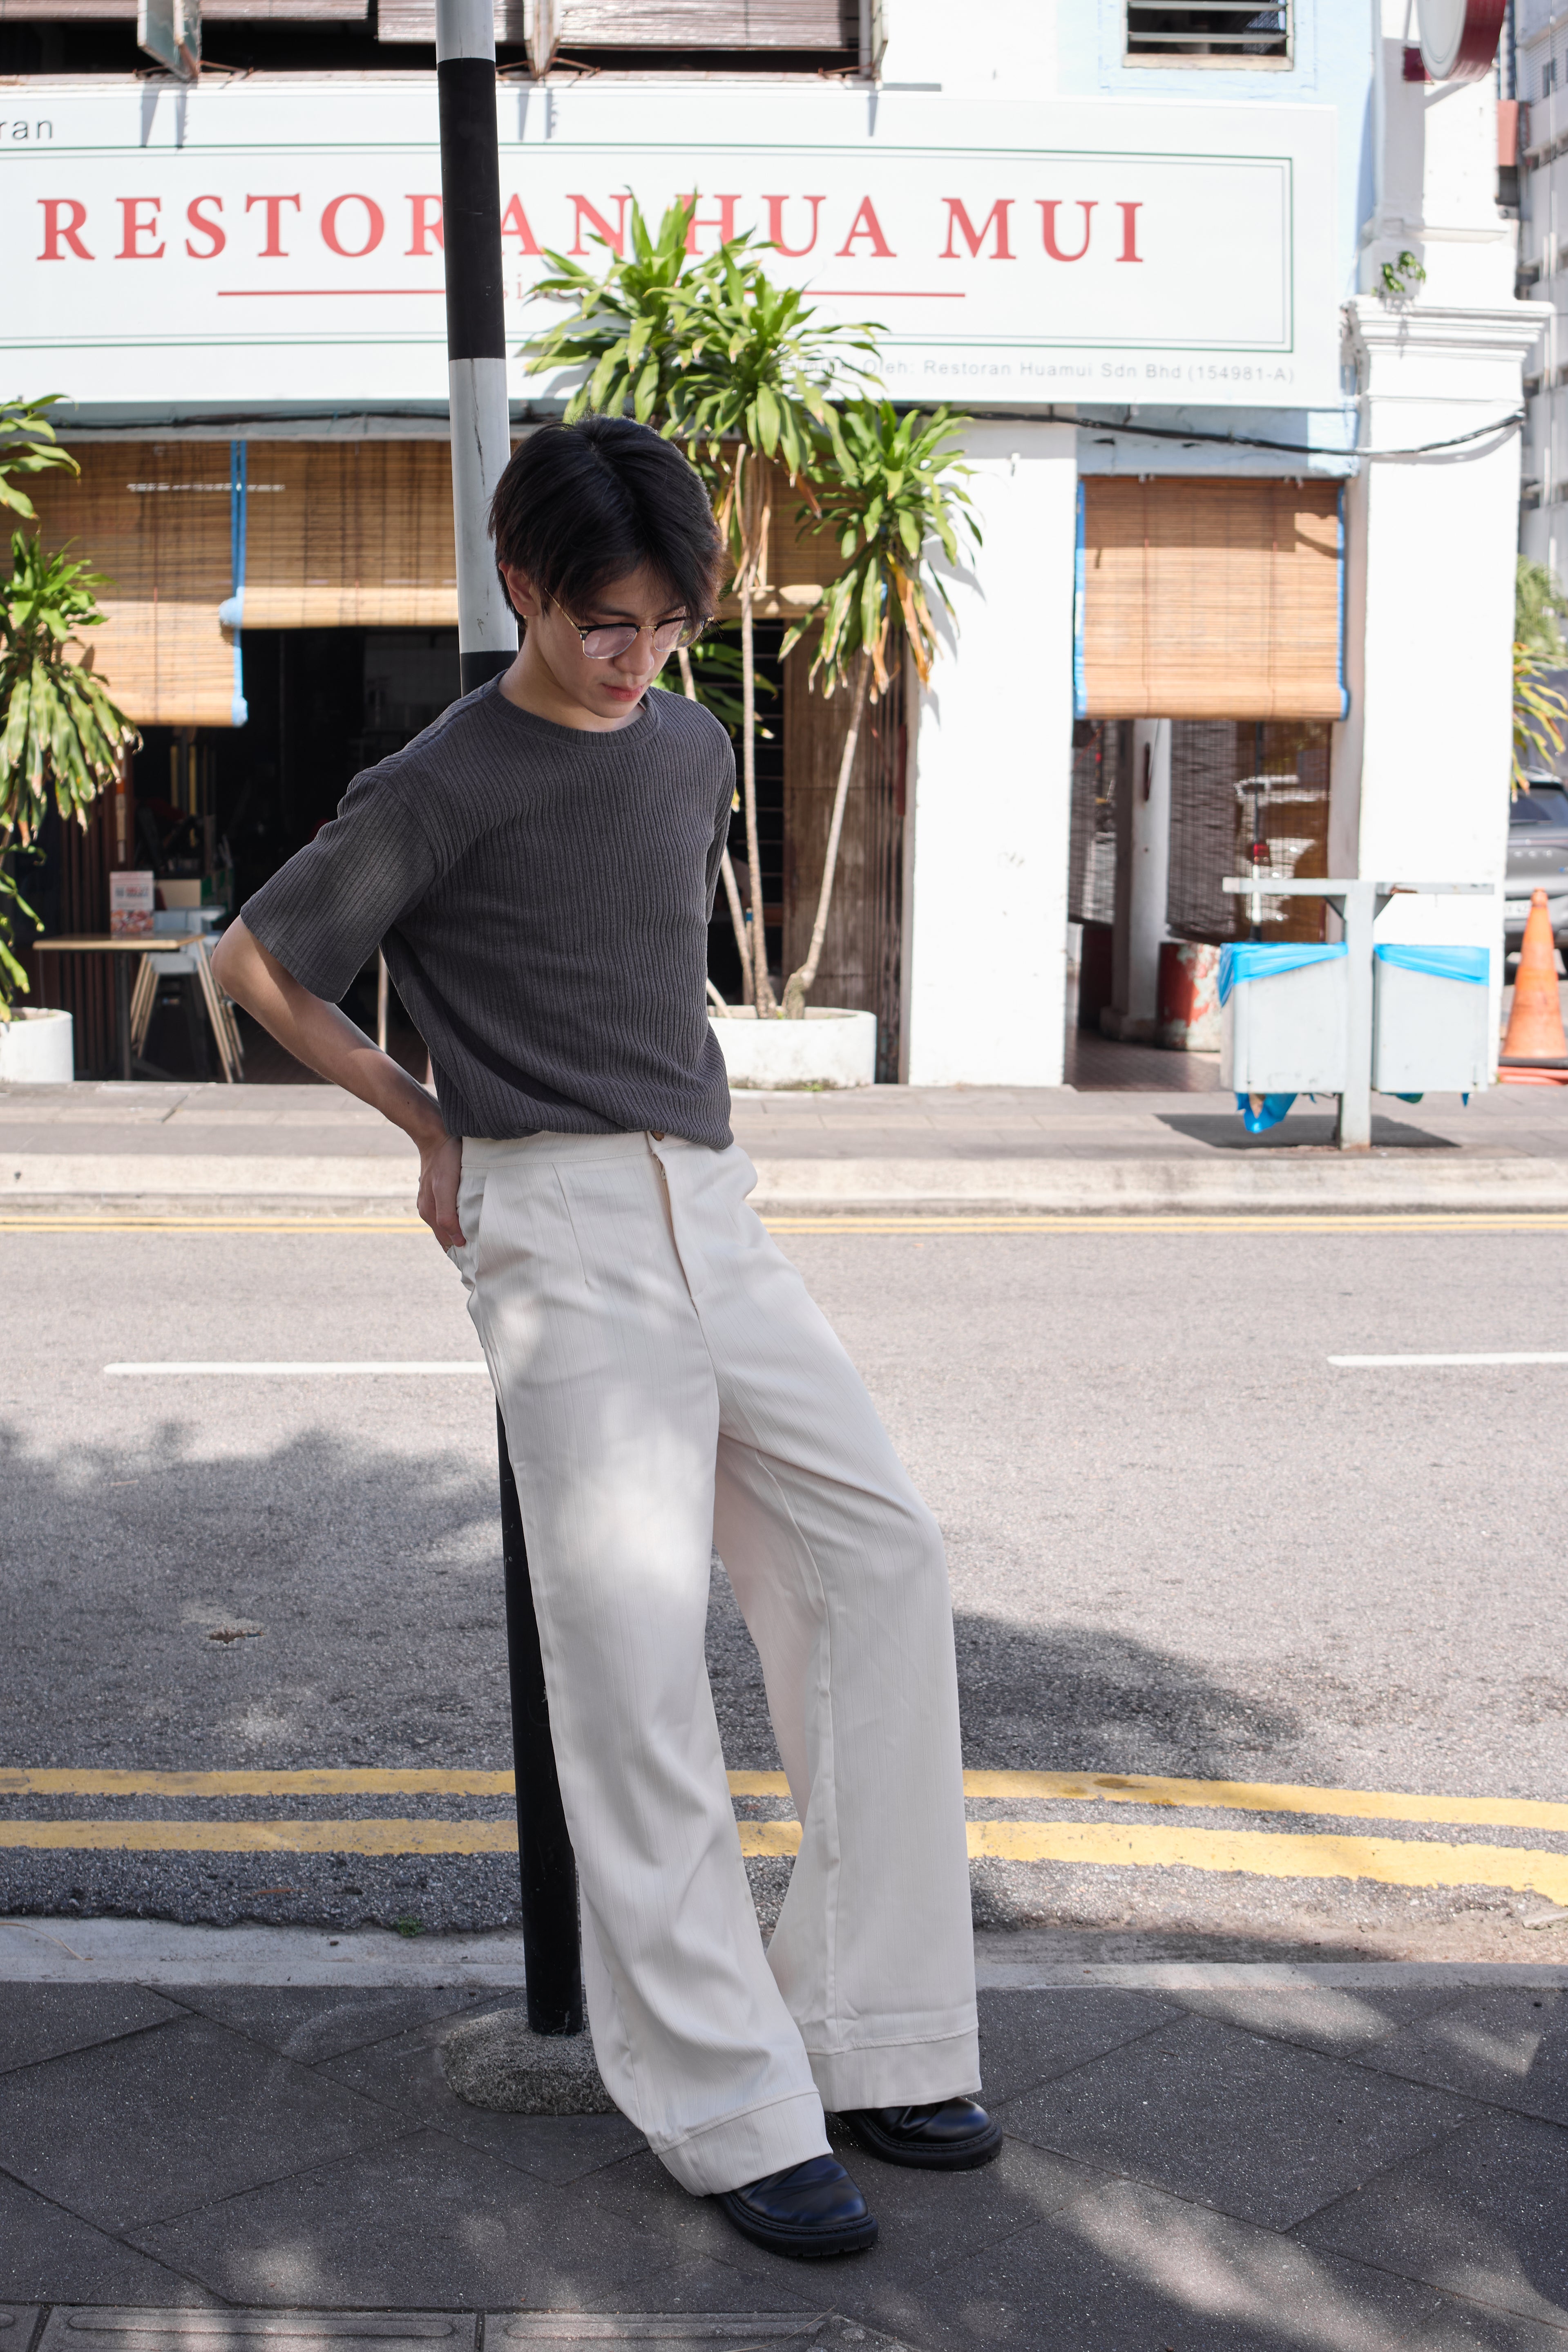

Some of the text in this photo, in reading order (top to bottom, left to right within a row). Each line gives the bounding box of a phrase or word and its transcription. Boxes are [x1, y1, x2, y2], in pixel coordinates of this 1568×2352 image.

[36, 192, 1144, 263] RESTORAN HUA MUI
[924, 359, 1011, 376] Restoran
[1020, 361, 1093, 377] Huamui
[1101, 362, 1138, 379] Sdn
[1145, 363, 1182, 380] Bhd
[1187, 364, 1295, 384] (154981-A)
